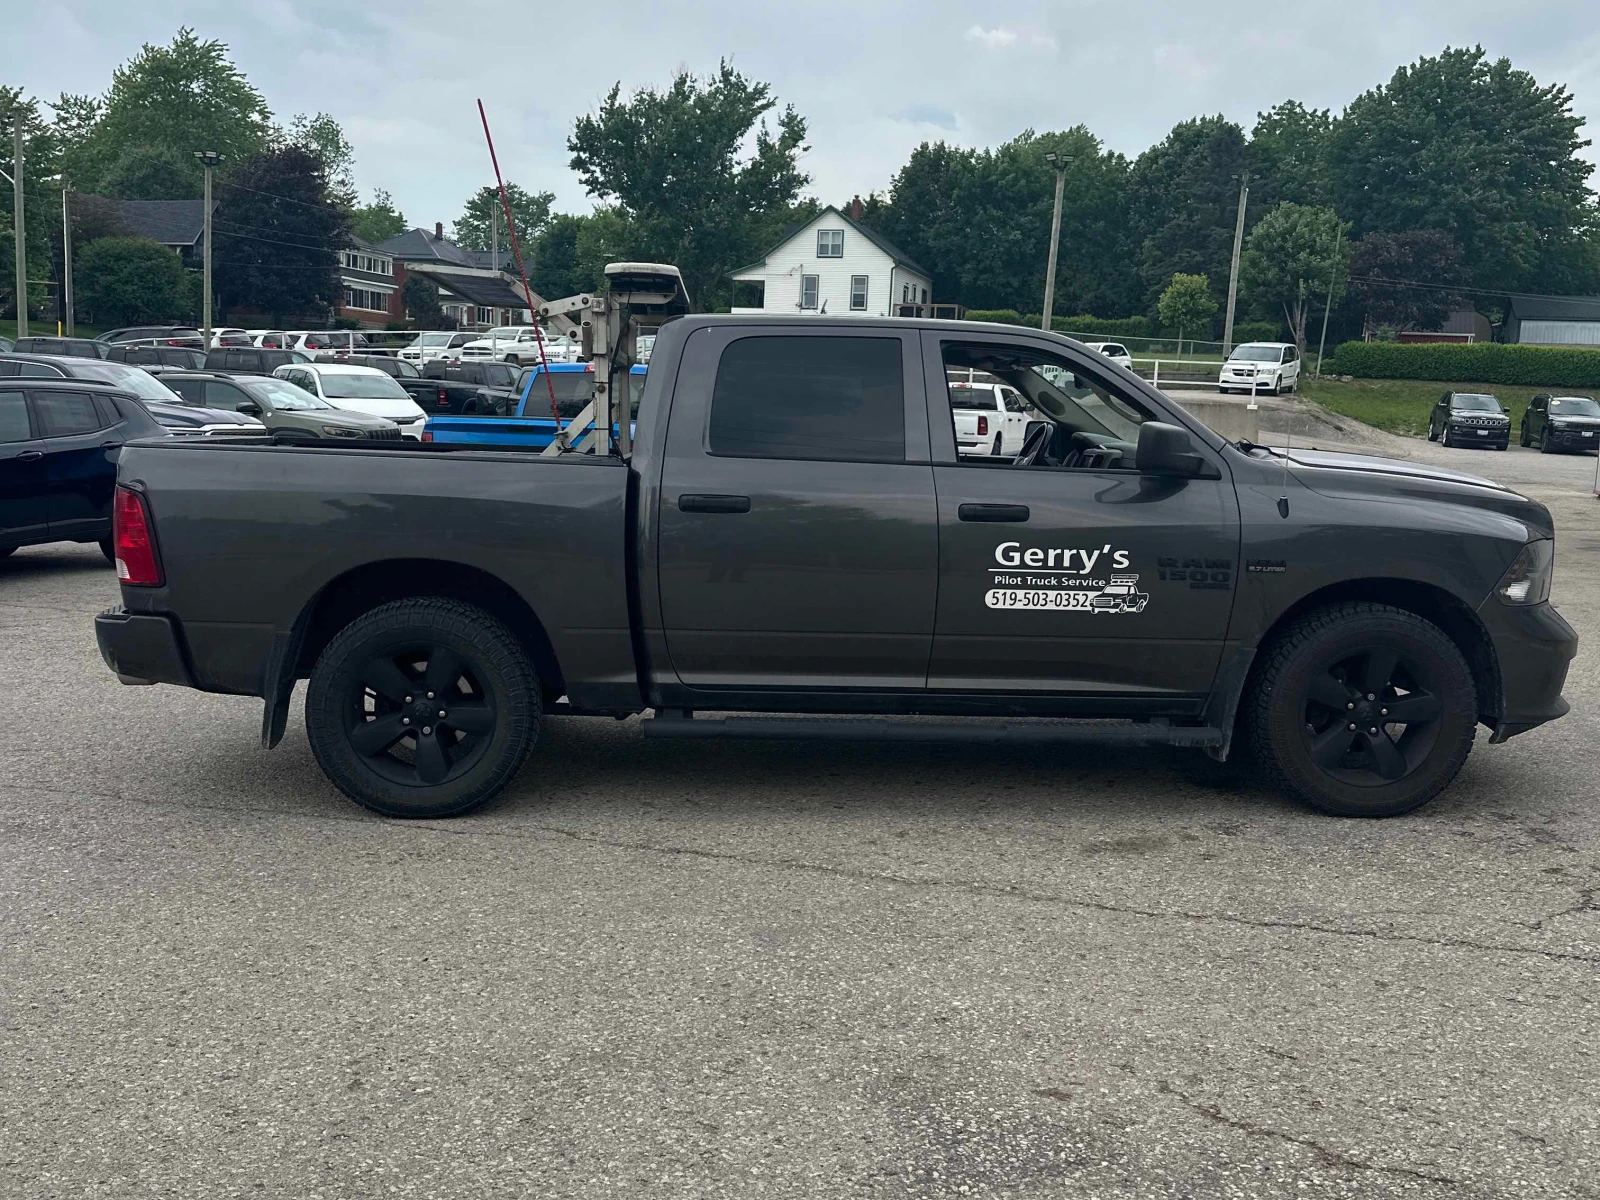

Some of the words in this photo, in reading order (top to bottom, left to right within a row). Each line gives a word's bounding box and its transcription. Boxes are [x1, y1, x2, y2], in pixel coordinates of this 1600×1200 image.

[994, 541, 1130, 574] Gerry's
[994, 575, 1022, 585] Pilot
[1026, 576, 1058, 586] Truck
[1062, 577, 1106, 587] Service
[1158, 570, 1231, 583] 1500
[991, 591, 1089, 608] 519-503-0352
